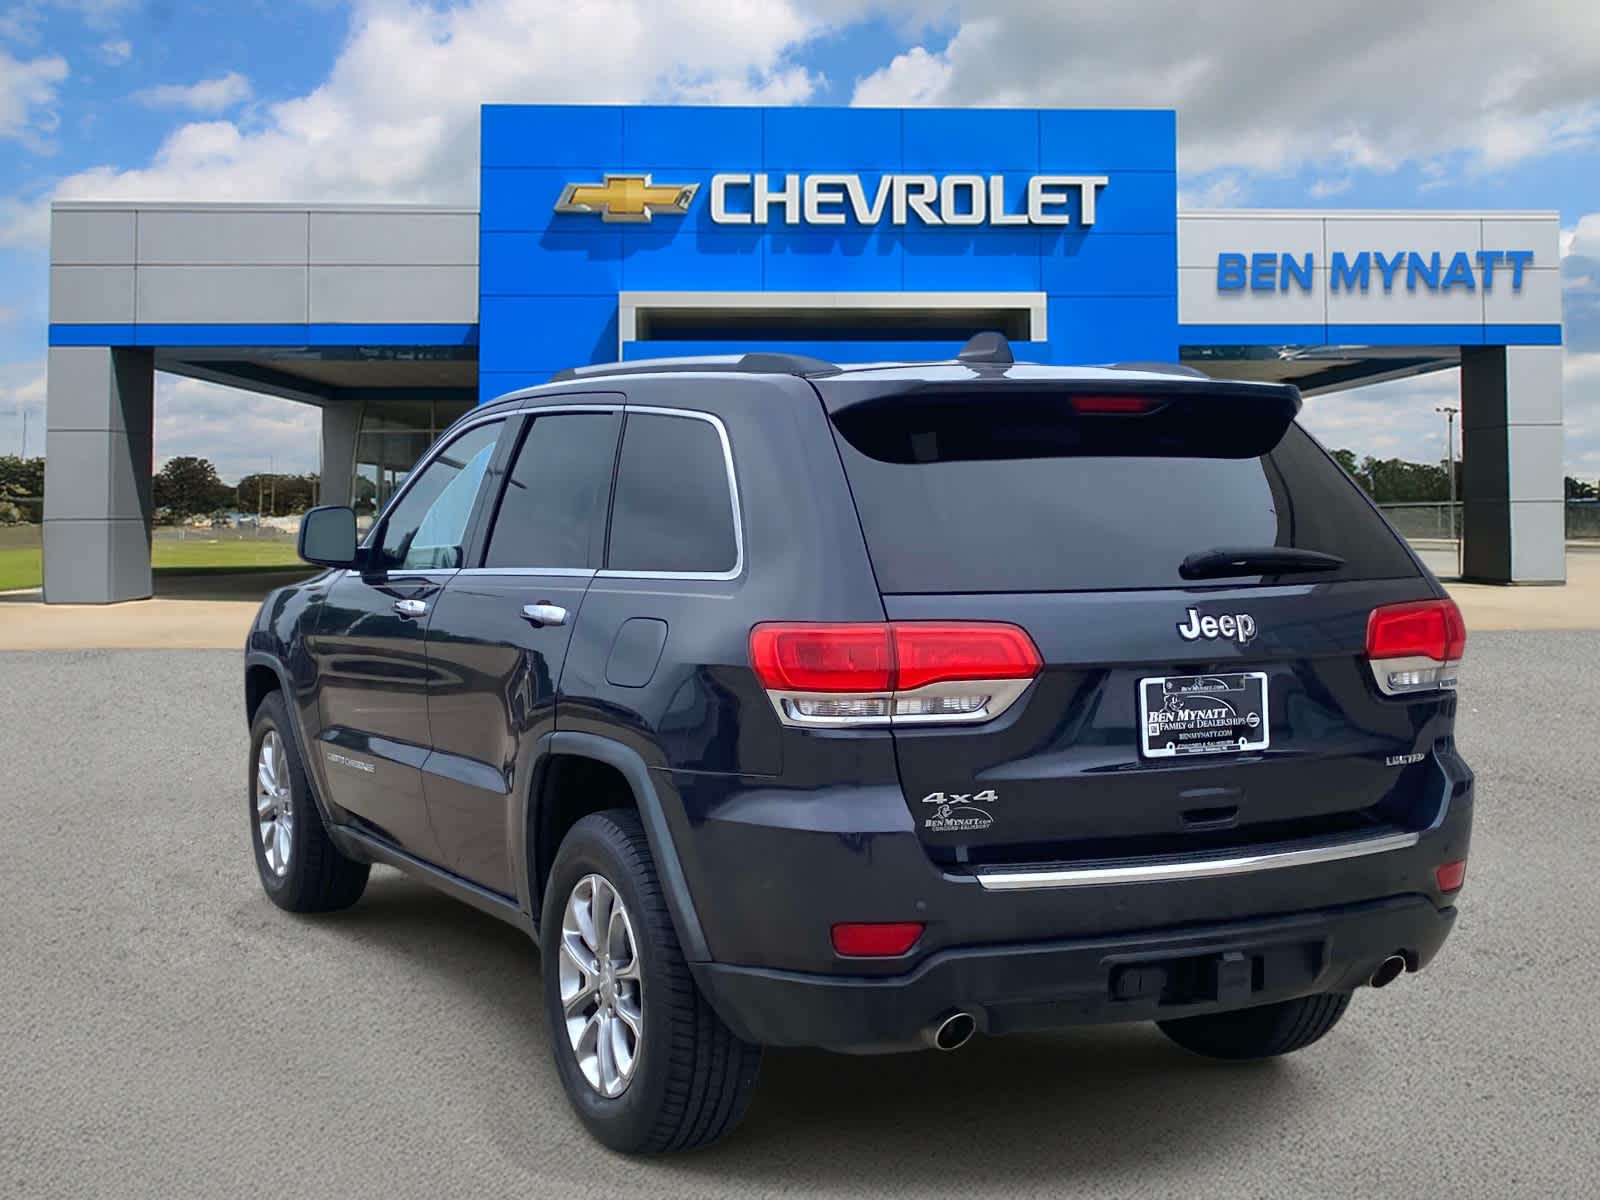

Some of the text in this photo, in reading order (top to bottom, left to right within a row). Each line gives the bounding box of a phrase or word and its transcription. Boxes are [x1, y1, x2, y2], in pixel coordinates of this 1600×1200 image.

[710, 174, 1109, 225] CHEVROLET
[1217, 250, 1535, 289] BEN MYNATT
[1179, 608, 1256, 643] Jeep
[1149, 708, 1229, 722] BEN MYNATT
[1160, 721, 1187, 731] FAMILY
[1196, 717, 1247, 729] DEALERSHIPS
[1179, 730, 1233, 740] BENMYNATT.COM
[922, 789, 998, 804] 4x4
